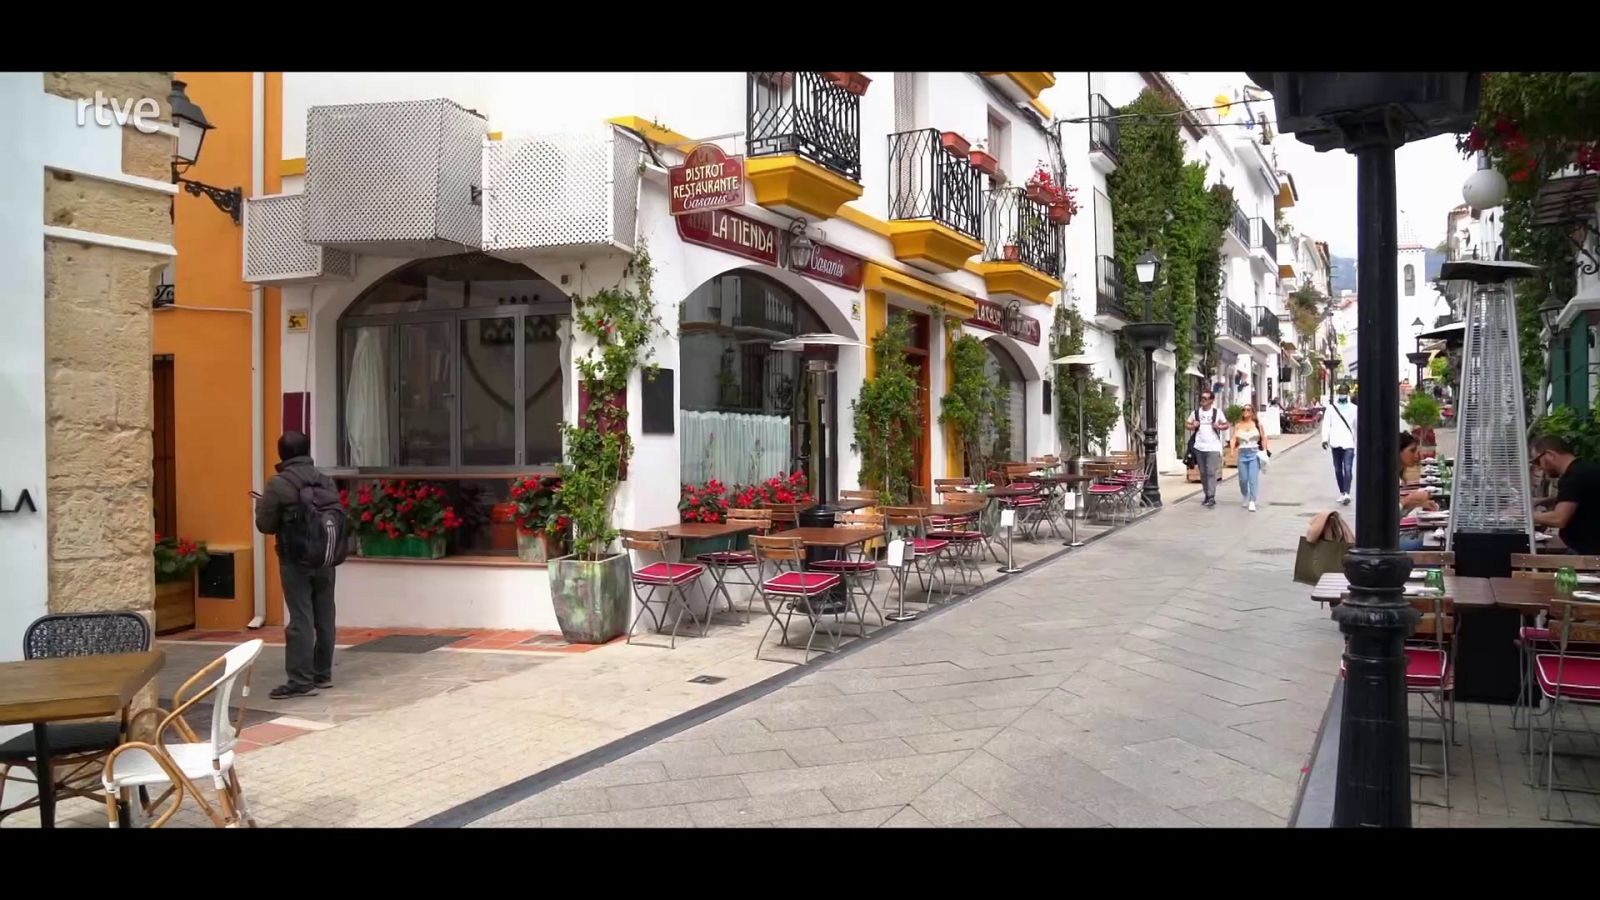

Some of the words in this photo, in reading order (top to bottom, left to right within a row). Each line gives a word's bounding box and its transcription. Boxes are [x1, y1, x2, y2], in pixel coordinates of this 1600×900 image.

[685, 162, 725, 181] BISTROT
[673, 176, 739, 198] RESTAURANTE
[683, 194, 728, 210] Casanis
[711, 211, 729, 239] LA
[730, 217, 774, 254] TIENDA
[810, 244, 844, 278] Casanis
